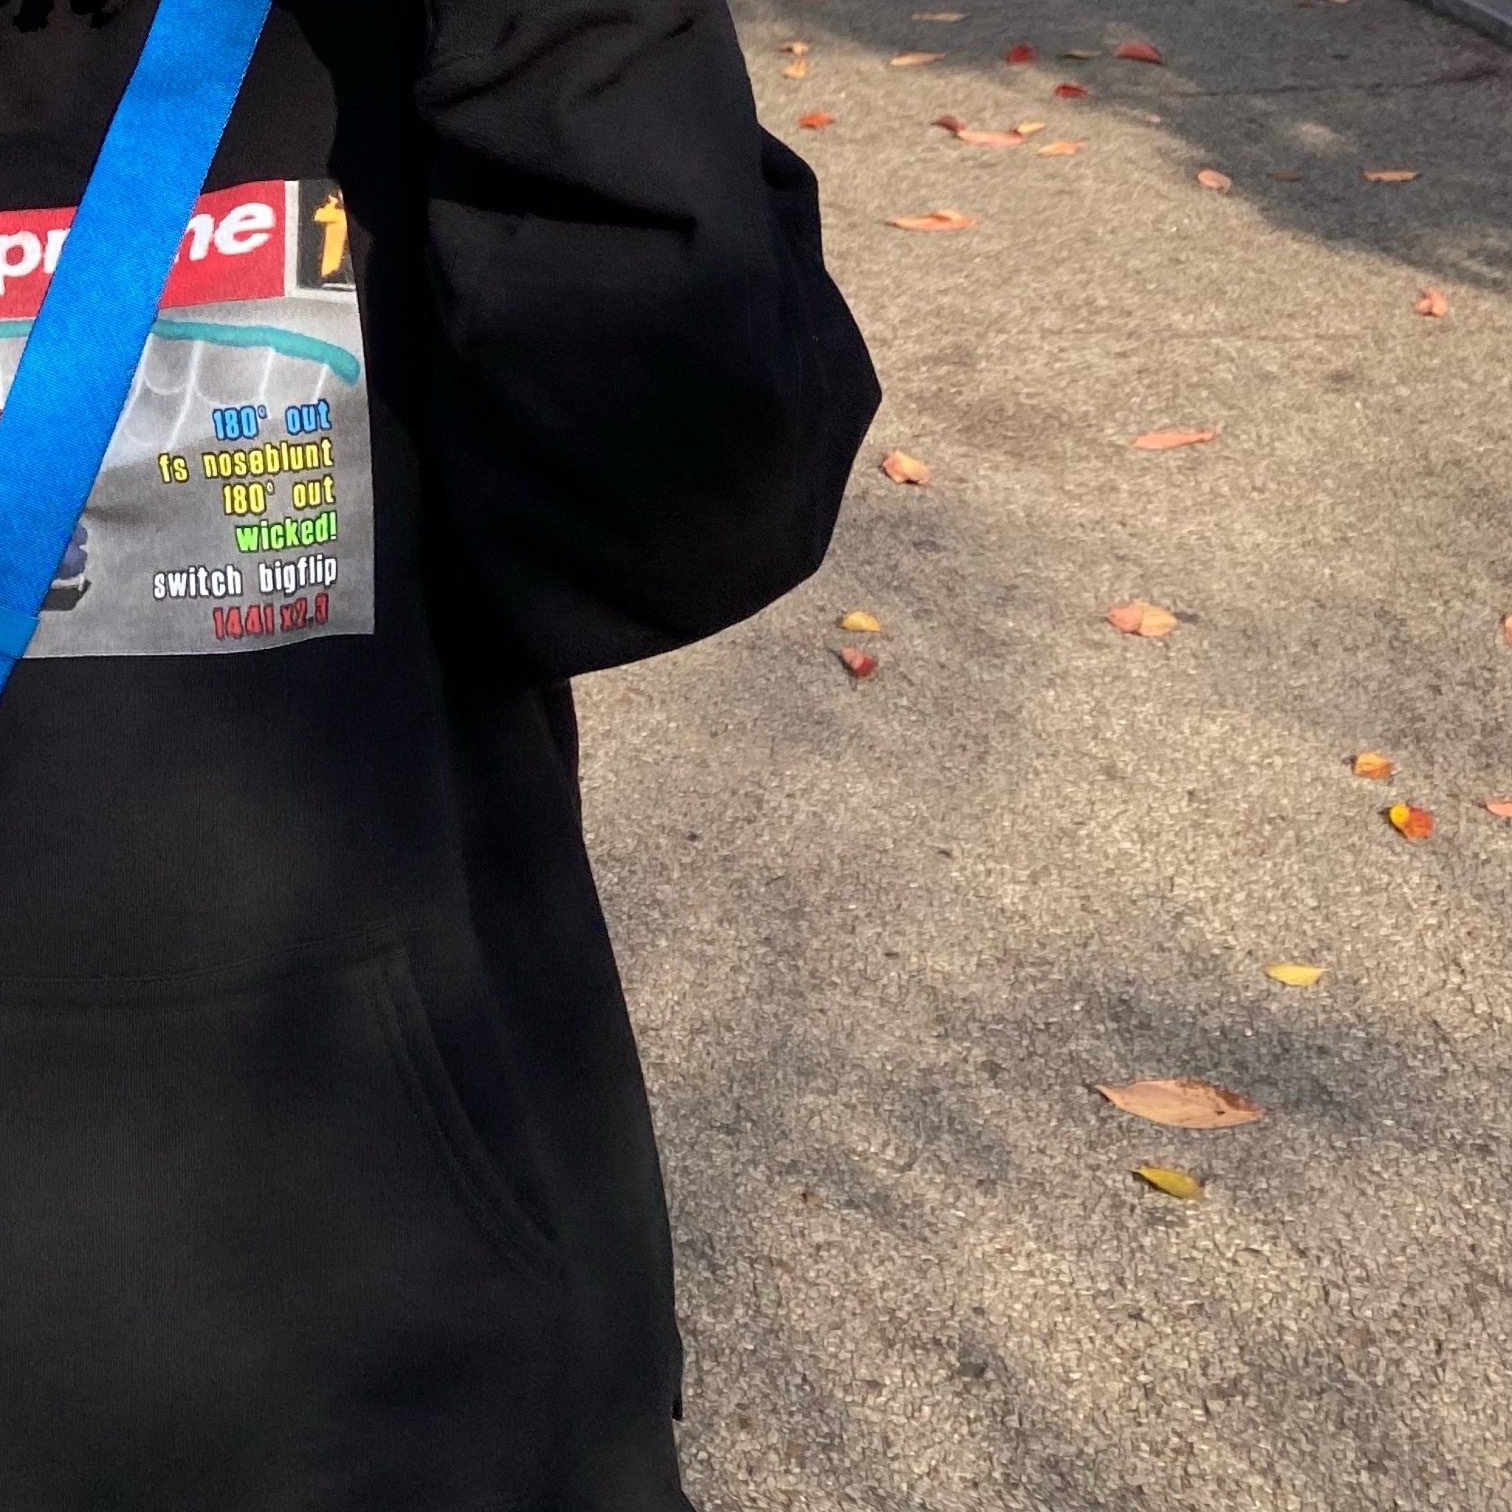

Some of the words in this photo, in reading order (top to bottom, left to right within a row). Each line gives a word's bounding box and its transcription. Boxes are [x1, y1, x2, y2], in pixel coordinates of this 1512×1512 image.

[285, 398, 333, 435] out
[158, 452, 189, 483] fs
[201, 437, 335, 479] noseblunt
[292, 473, 336, 510] out
[235, 510, 337, 553] wicked!
[152, 563, 244, 600] switch
[257, 553, 337, 596] bigflip
